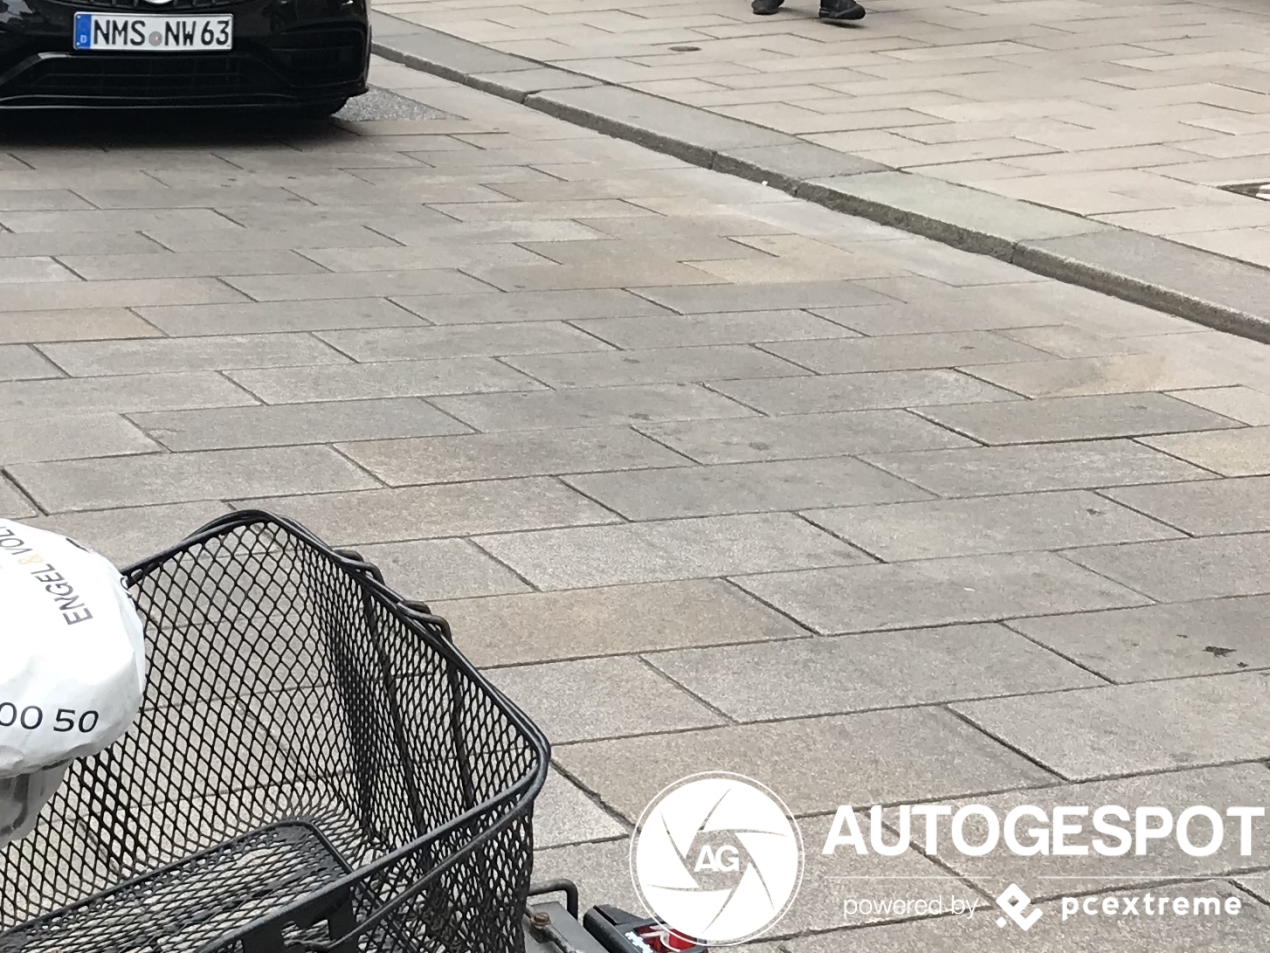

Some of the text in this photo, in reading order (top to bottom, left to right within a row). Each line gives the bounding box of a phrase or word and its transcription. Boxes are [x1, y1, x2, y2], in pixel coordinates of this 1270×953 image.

[93, 19, 230, 47] NMS NW 63
[30, 563, 94, 625] ENGEL
[53, 708, 99, 733] 50
